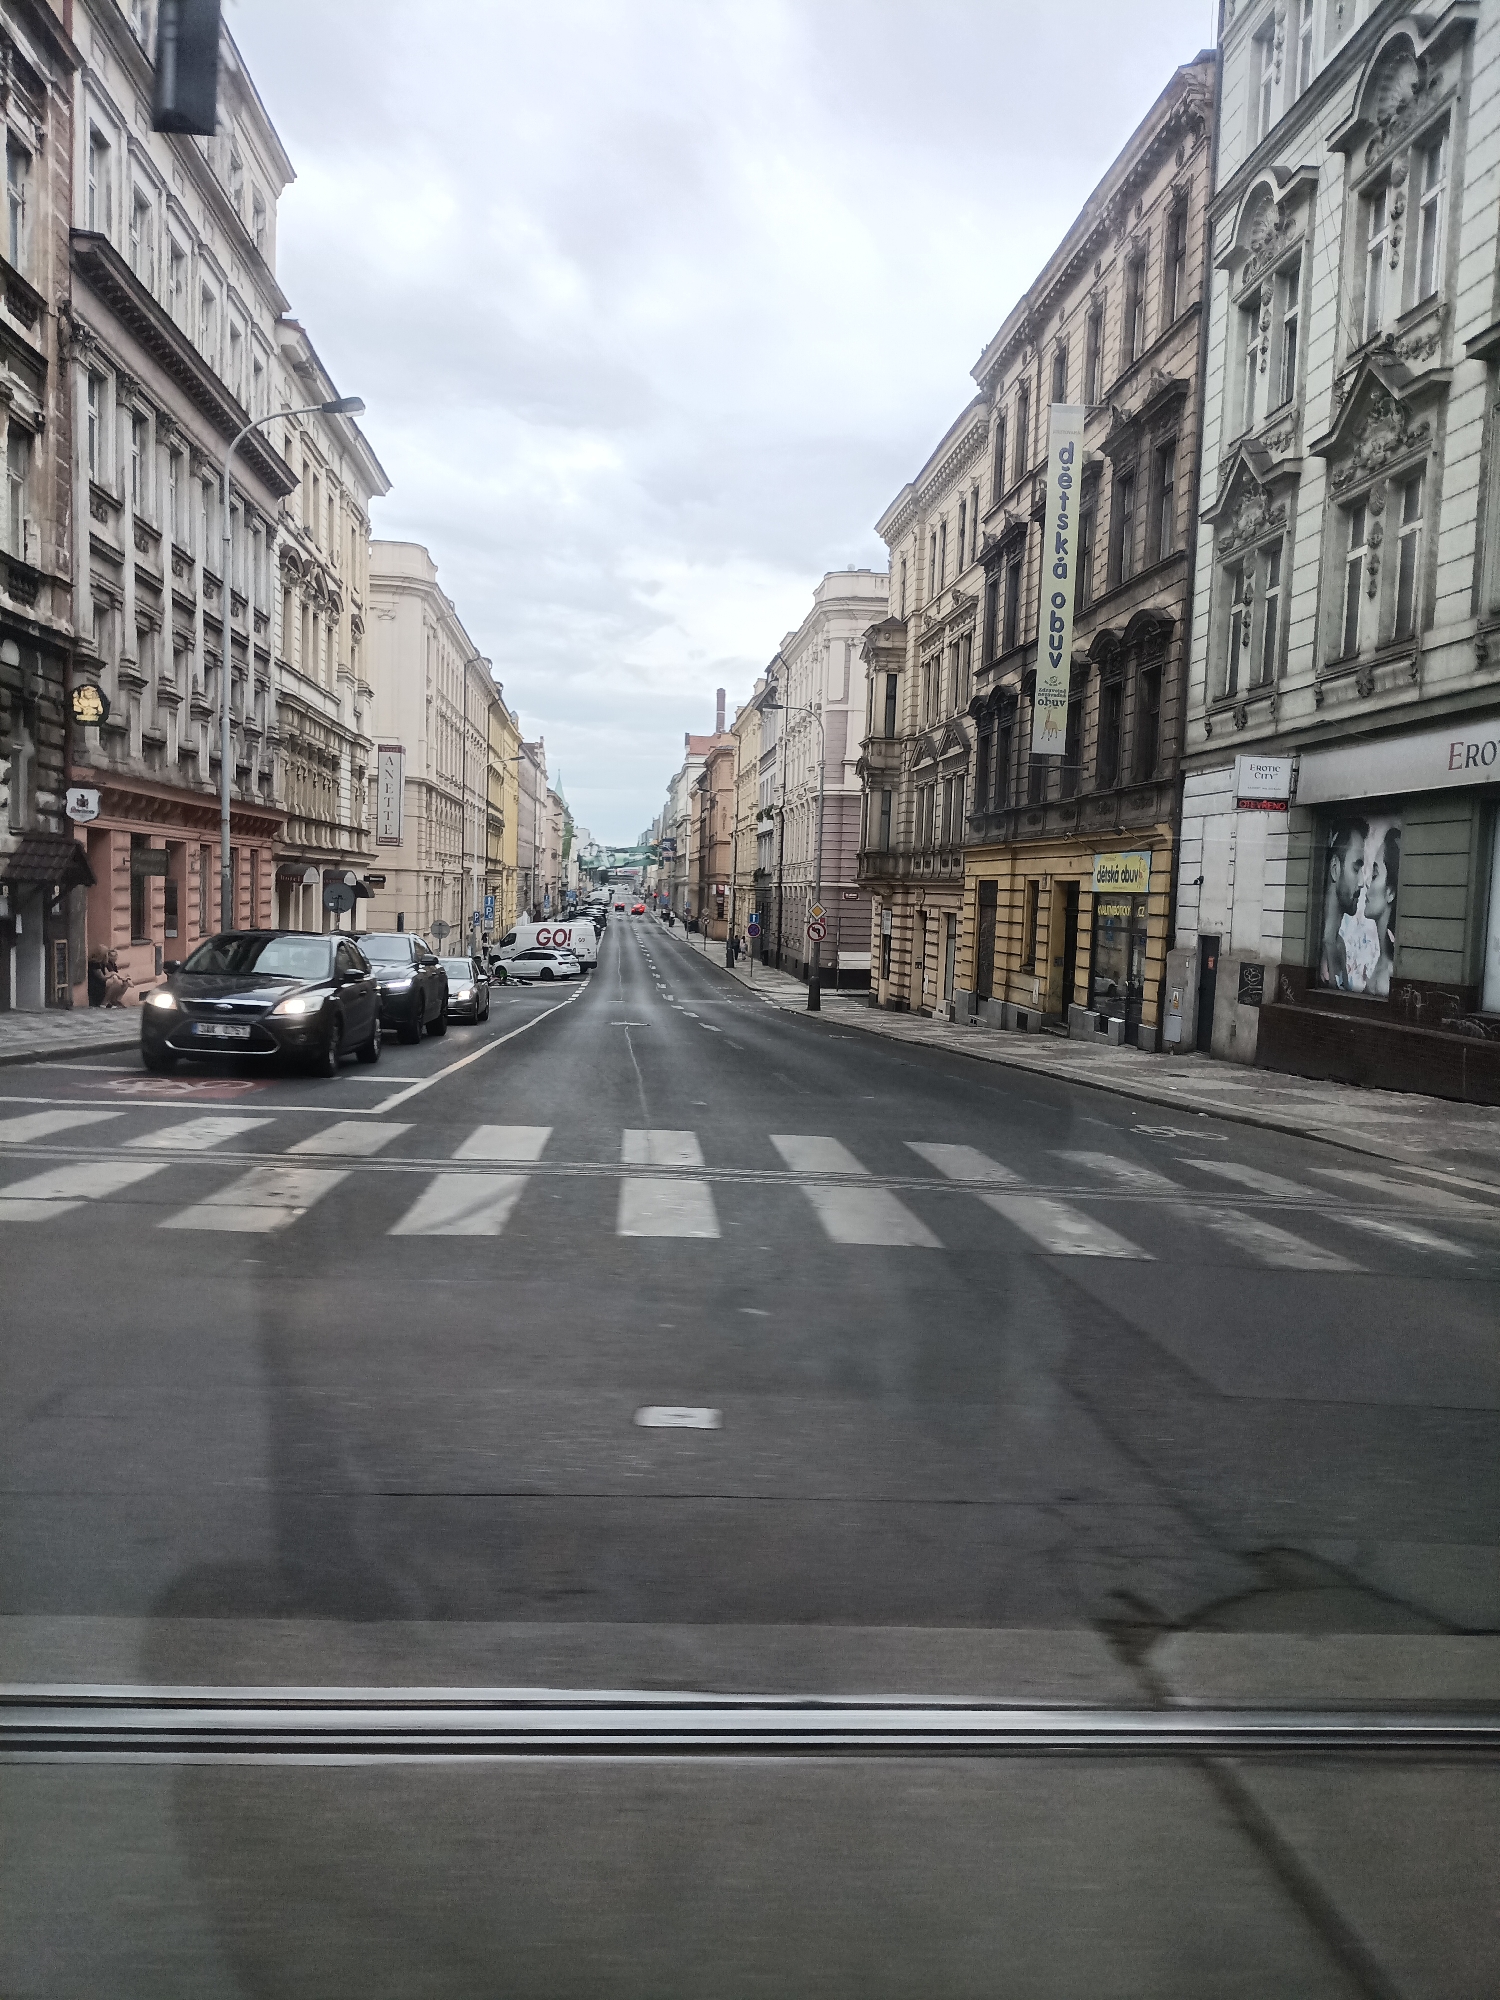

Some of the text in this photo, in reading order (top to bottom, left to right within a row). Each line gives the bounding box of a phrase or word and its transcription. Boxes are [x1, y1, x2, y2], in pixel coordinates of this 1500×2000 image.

[1053, 441, 1074, 579] dětská
[1048, 591, 1067, 669] obuv
[1037, 697, 1067, 707] obuv
[1447, 739, 1500, 771] ERO
[383, 755, 394, 835] ANETTE
[1096, 863, 1139, 884] dětská obuv
[535, 927, 573, 948] GO!
